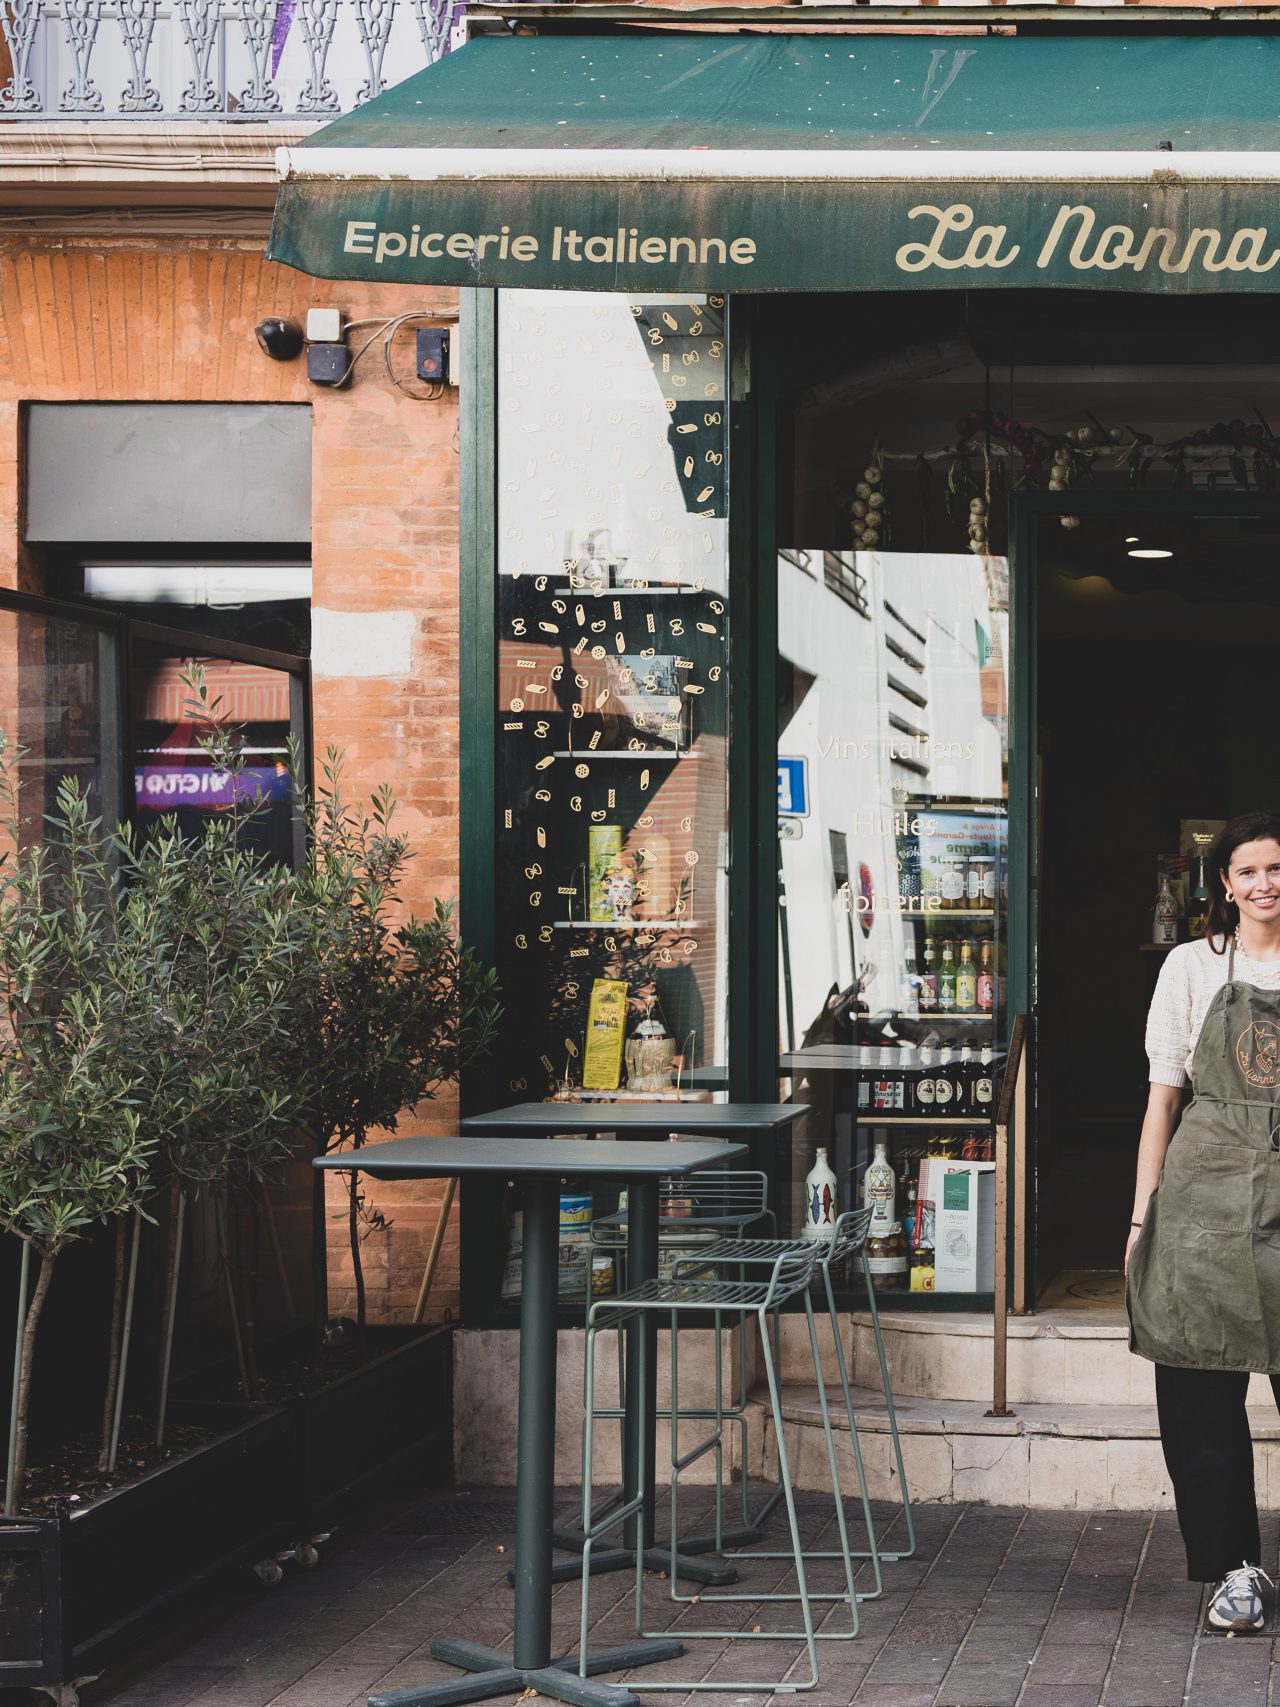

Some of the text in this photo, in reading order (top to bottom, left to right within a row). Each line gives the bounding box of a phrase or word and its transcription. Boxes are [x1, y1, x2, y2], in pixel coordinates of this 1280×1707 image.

[343, 220, 758, 266] Epicerie Italienne
[894, 203, 1021, 273] La
[815, 735, 976, 760] Vins italiens
[852, 811, 937, 836] Huiles
[836, 881, 943, 920] Épicerie
[1240, 1050, 1249, 1069] La
[1246, 1070, 1276, 1085] Nonna
